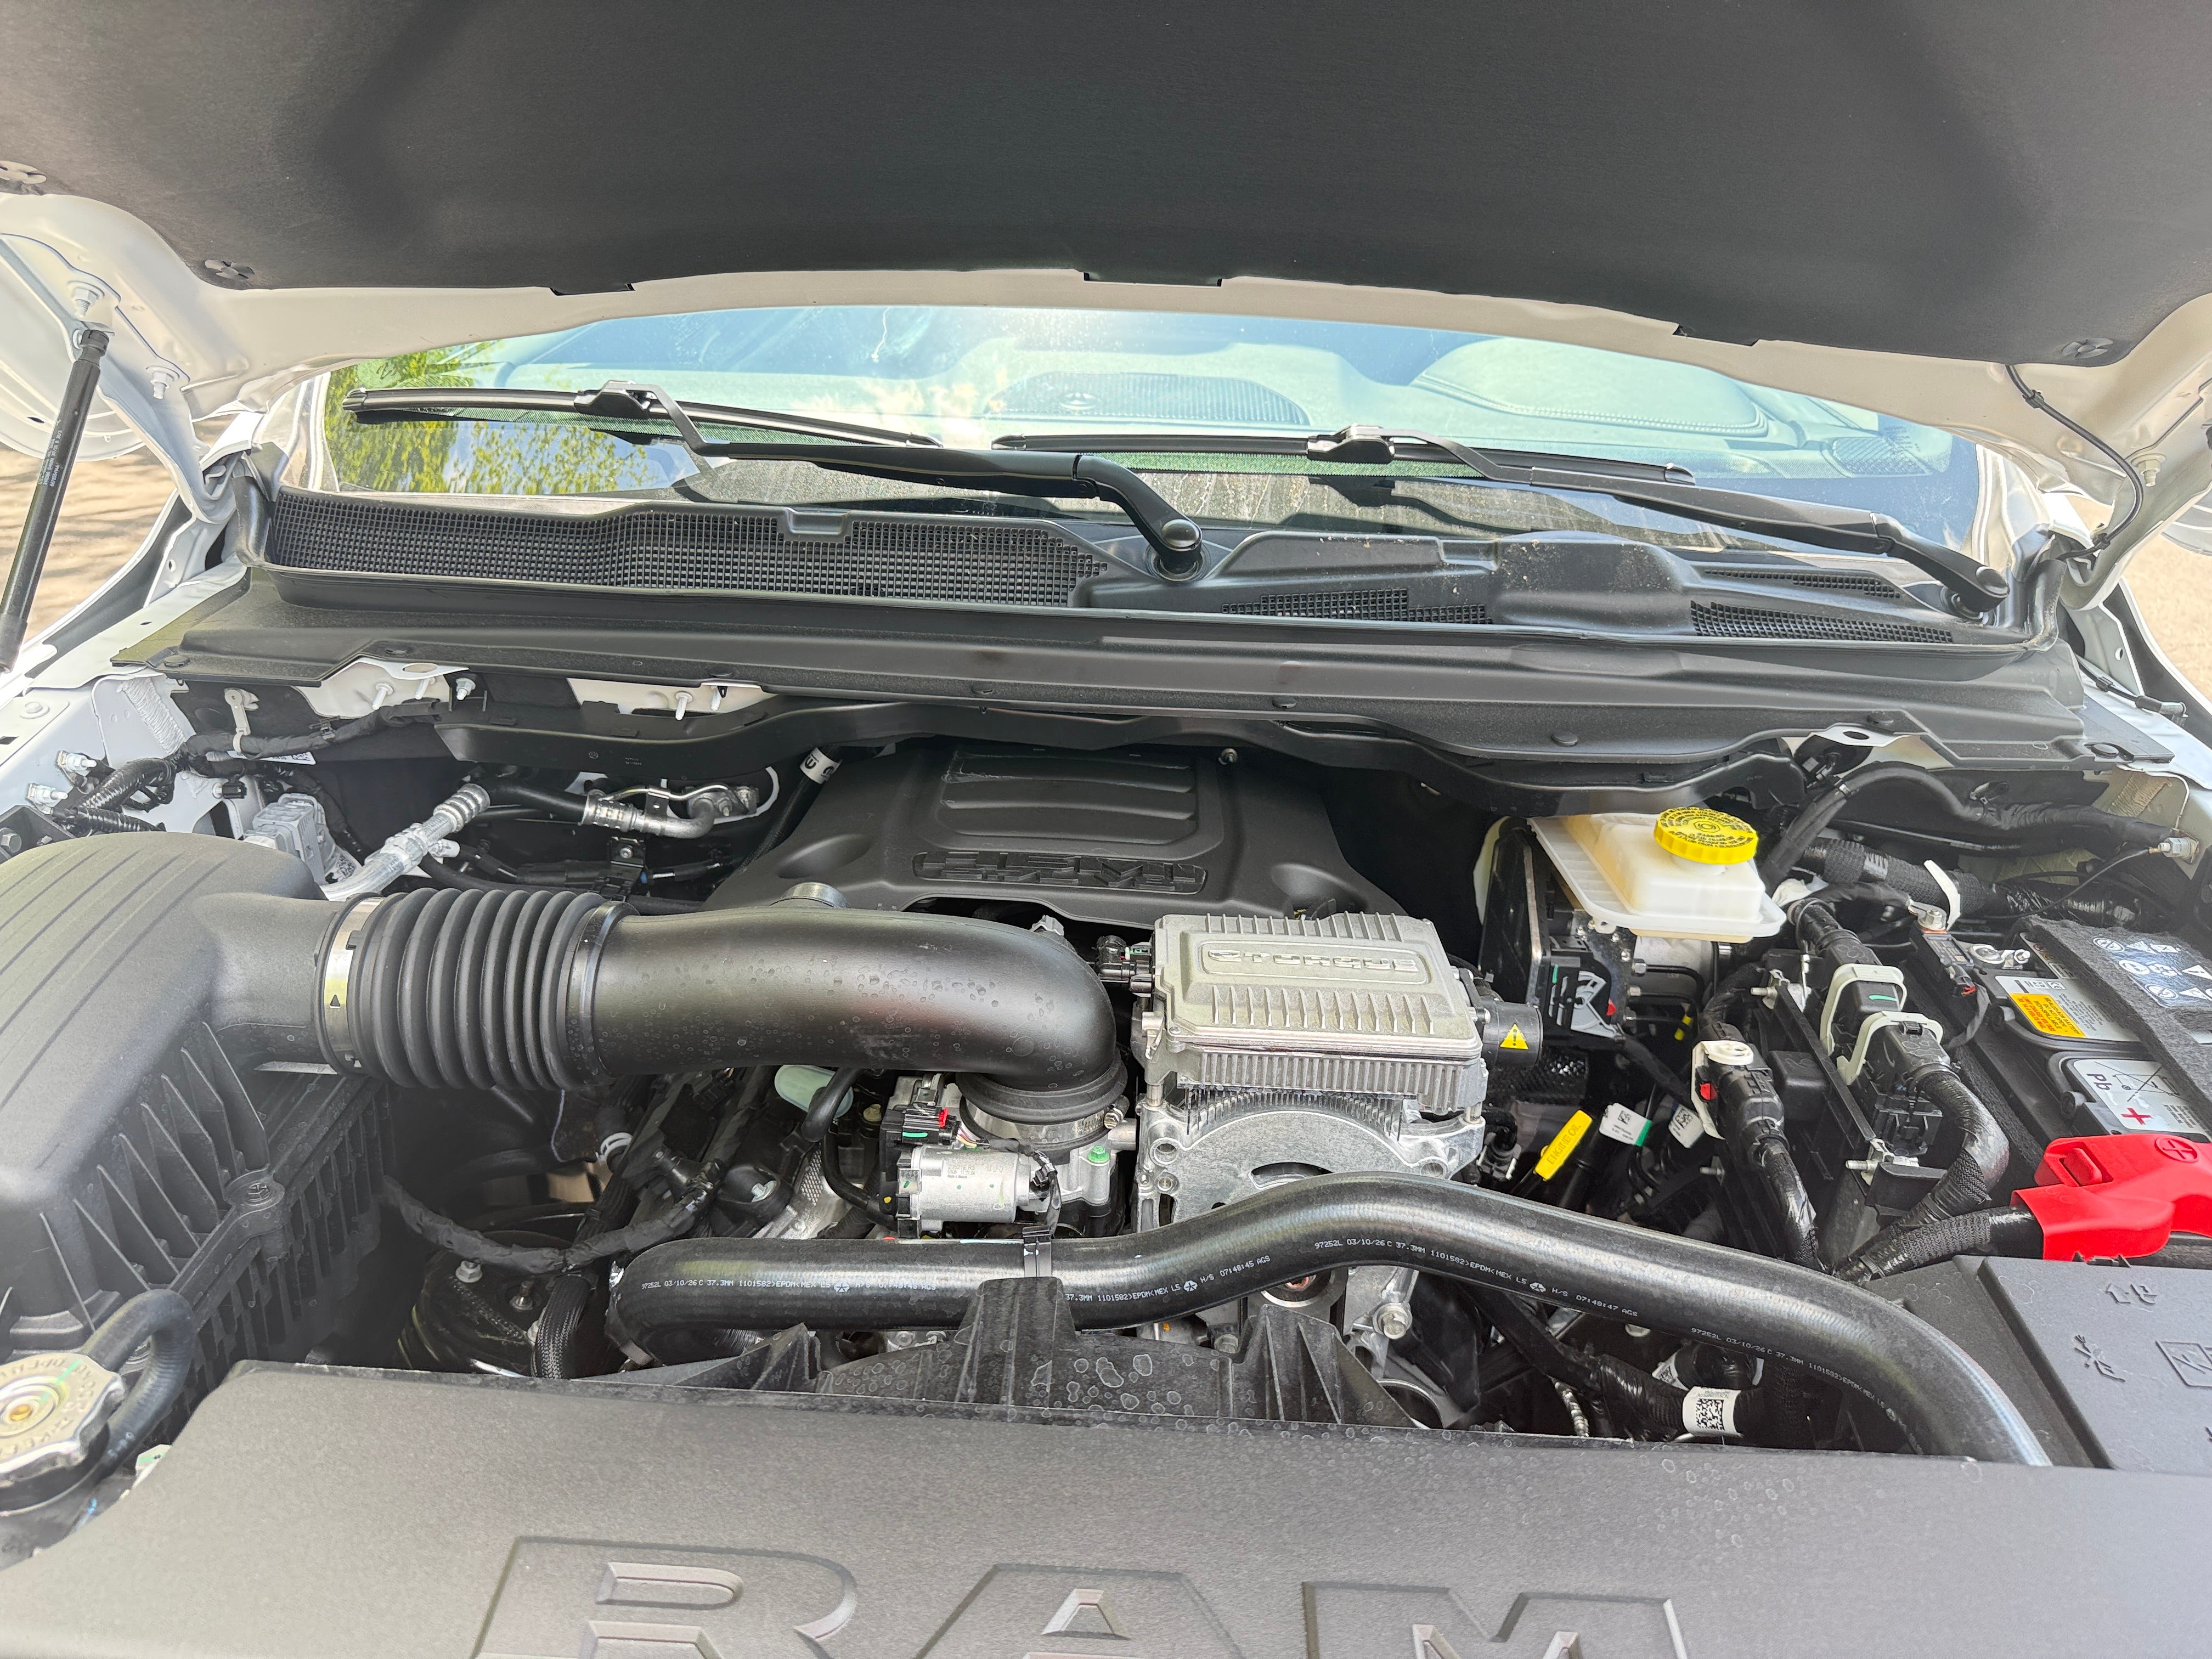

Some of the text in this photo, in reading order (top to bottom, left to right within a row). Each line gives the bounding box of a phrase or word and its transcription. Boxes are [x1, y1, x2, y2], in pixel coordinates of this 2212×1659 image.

[2086, 1074, 2112, 1091] Pb
[1547, 1135, 1572, 1165] ENGINE
[1065, 1293, 1093, 1301] 37.3MM
[1200, 1274, 1215, 1283] H/S
[1220, 1260, 1255, 1277] 07:48:45
[1256, 1255, 1271, 1265] AGS
[1314, 1240, 1343, 1249] 97252L
[1395, 1242, 1426, 1254] 37.3MM
[1552, 1288, 1568, 1297] H/S
[1576, 1295, 1618, 1311] 07:48:47
[1621, 1308, 1638, 1317] AGS
[1691, 1327, 1722, 1340] 97252L
[1726, 1337, 1765, 1352] 03/10/26
[1775, 1351, 1804, 1365] 37.3MM
[469, 1535, 1688, 1659] RAM
